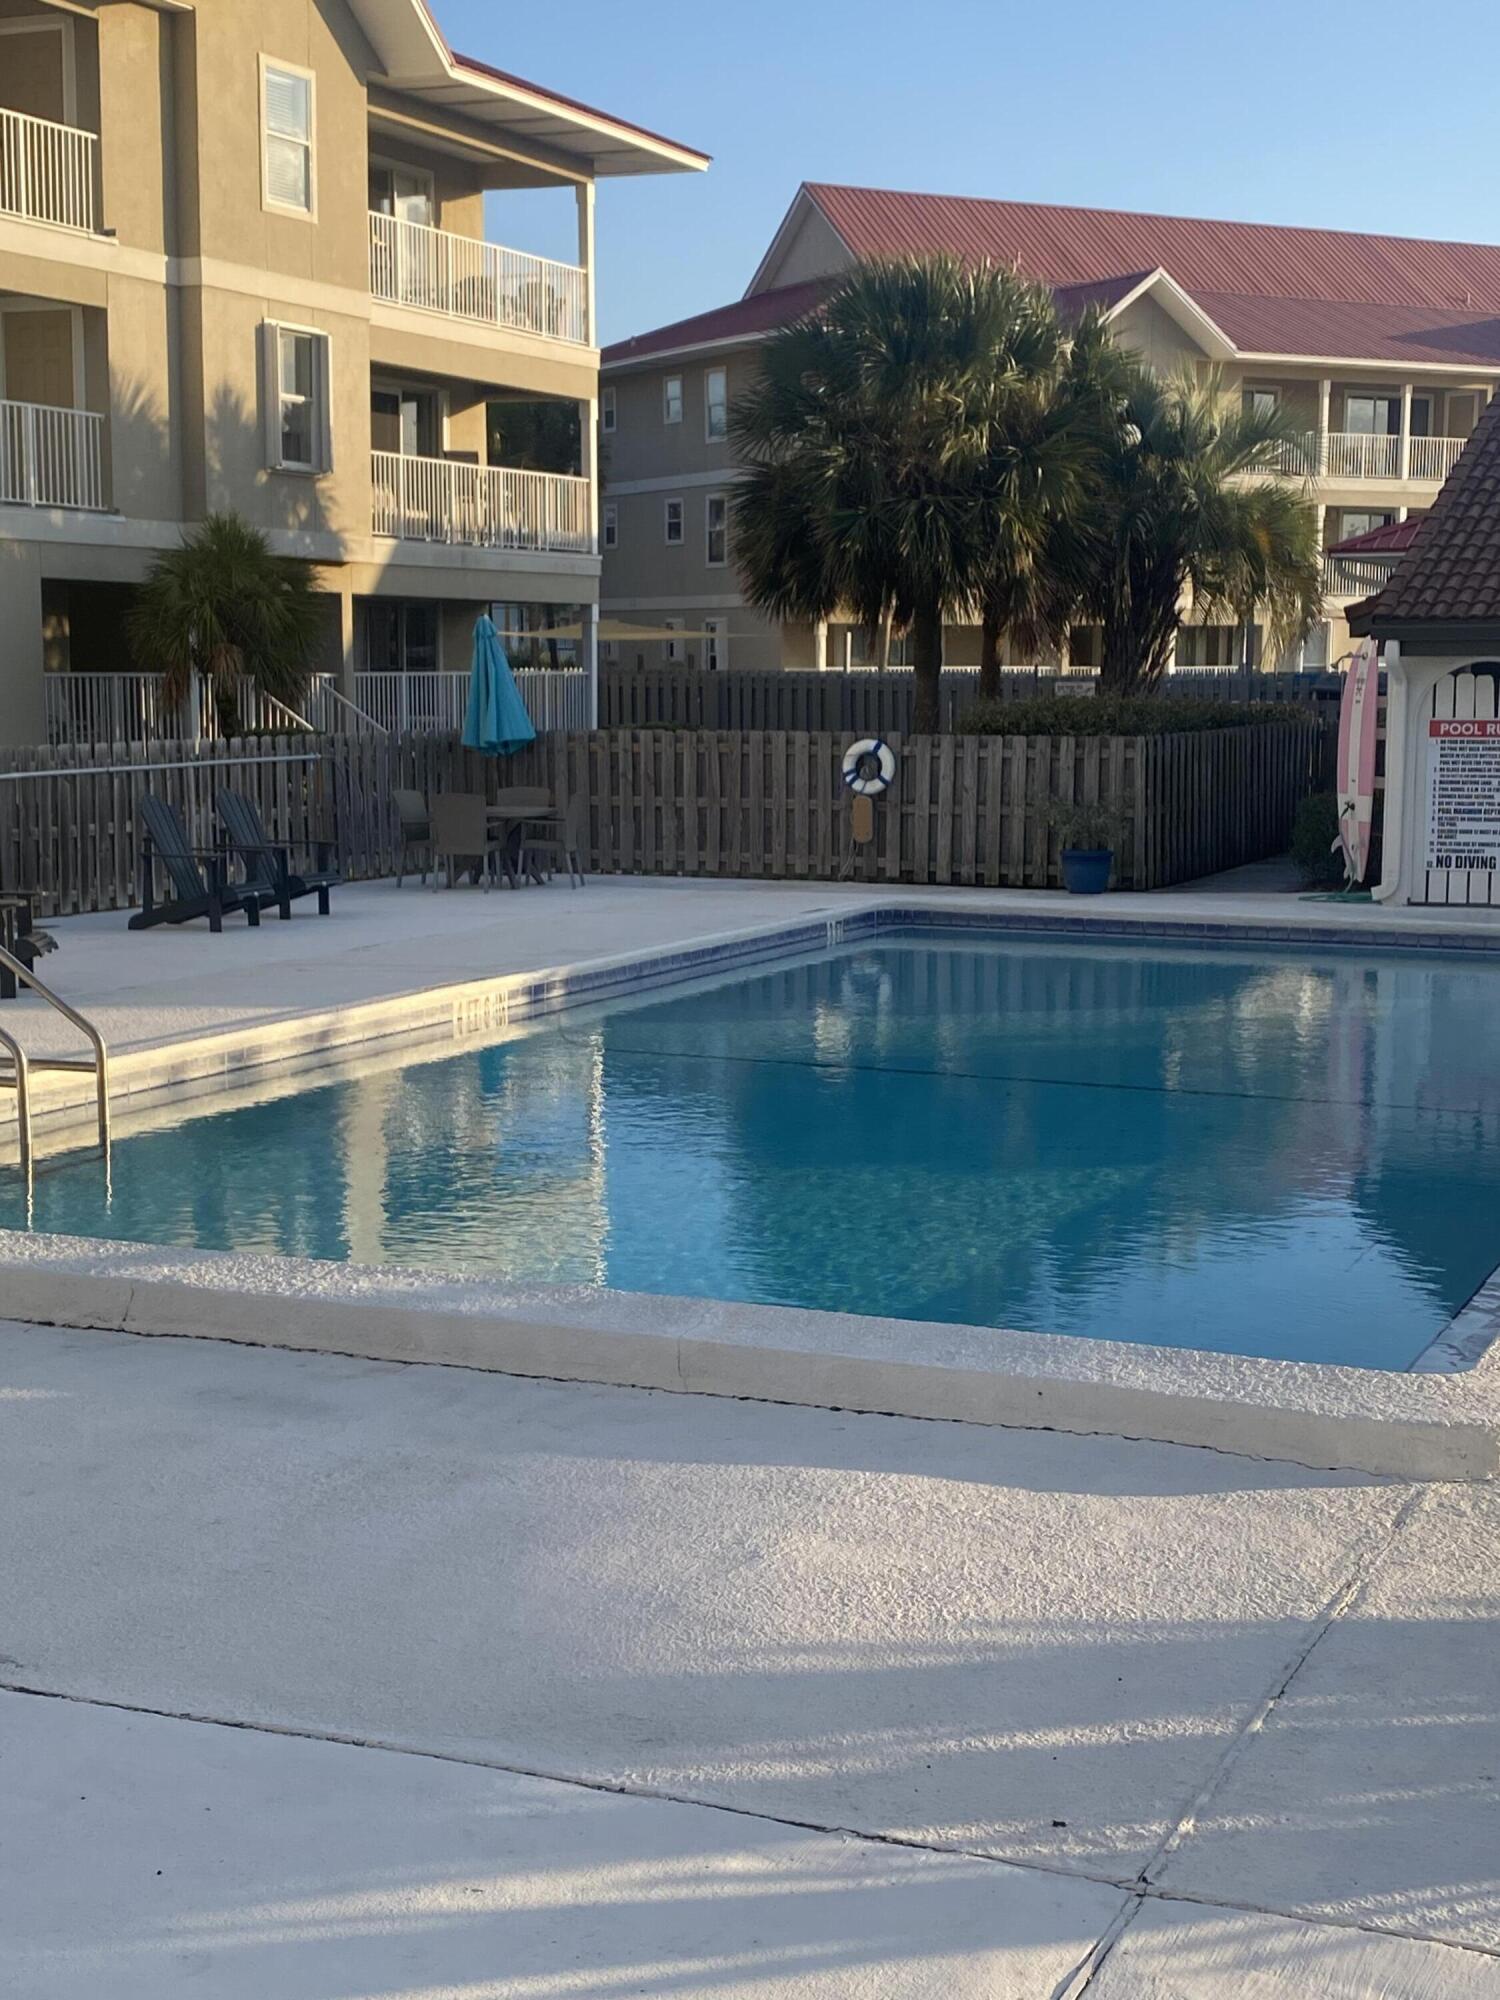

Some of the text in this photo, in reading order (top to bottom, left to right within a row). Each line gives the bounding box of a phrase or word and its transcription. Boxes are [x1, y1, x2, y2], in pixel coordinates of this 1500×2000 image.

[1440, 723, 1482, 735] POOL
[1436, 855, 1452, 868] NO
[1455, 856, 1496, 870] DIVING
